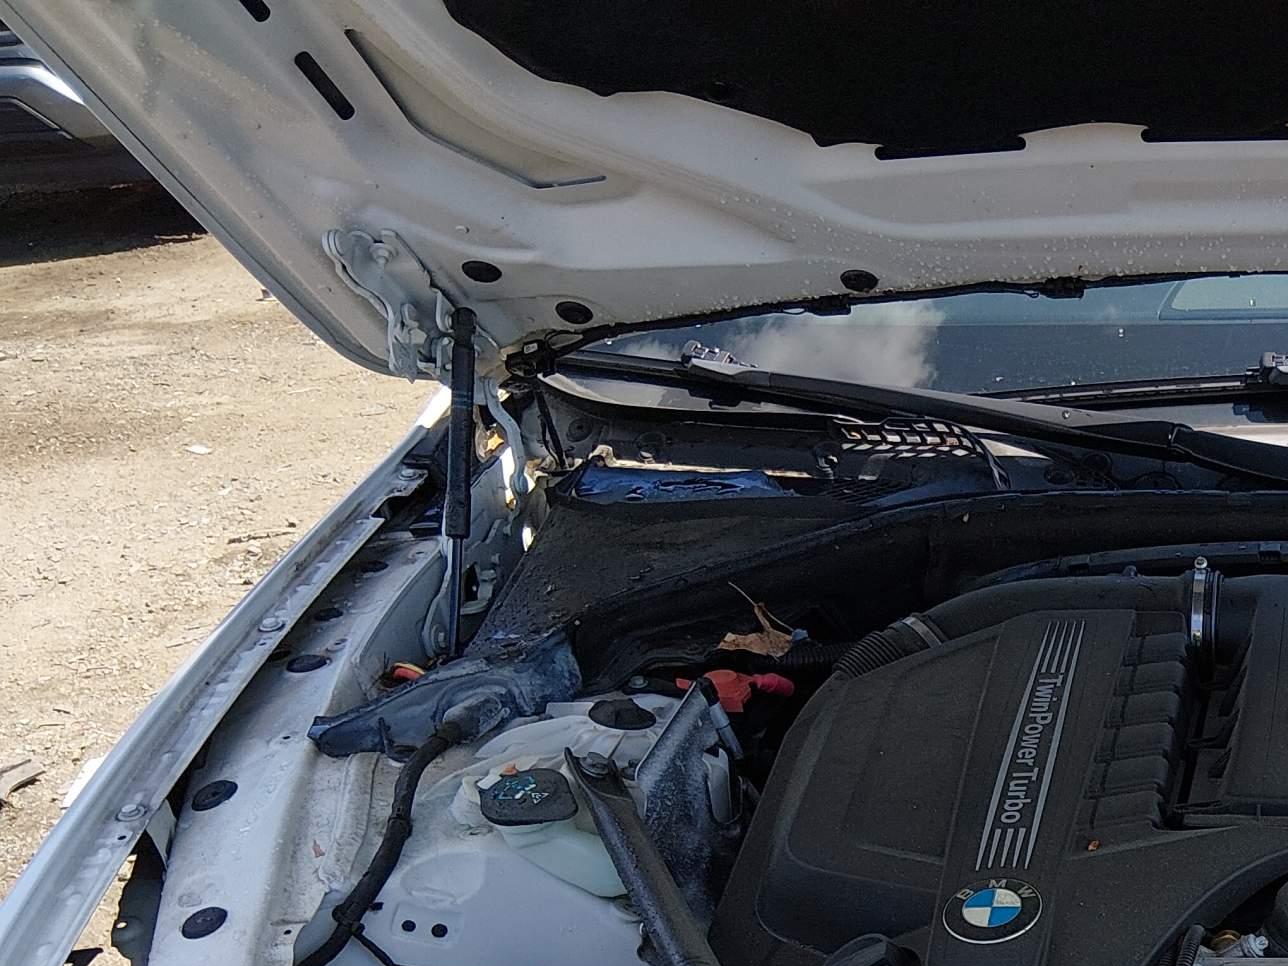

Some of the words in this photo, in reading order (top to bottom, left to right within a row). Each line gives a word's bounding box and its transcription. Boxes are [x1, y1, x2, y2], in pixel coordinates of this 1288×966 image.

[1016, 672, 1064, 767] TwinPower
[1001, 767, 1039, 824] Turbo
[956, 879, 1037, 900] BMW
